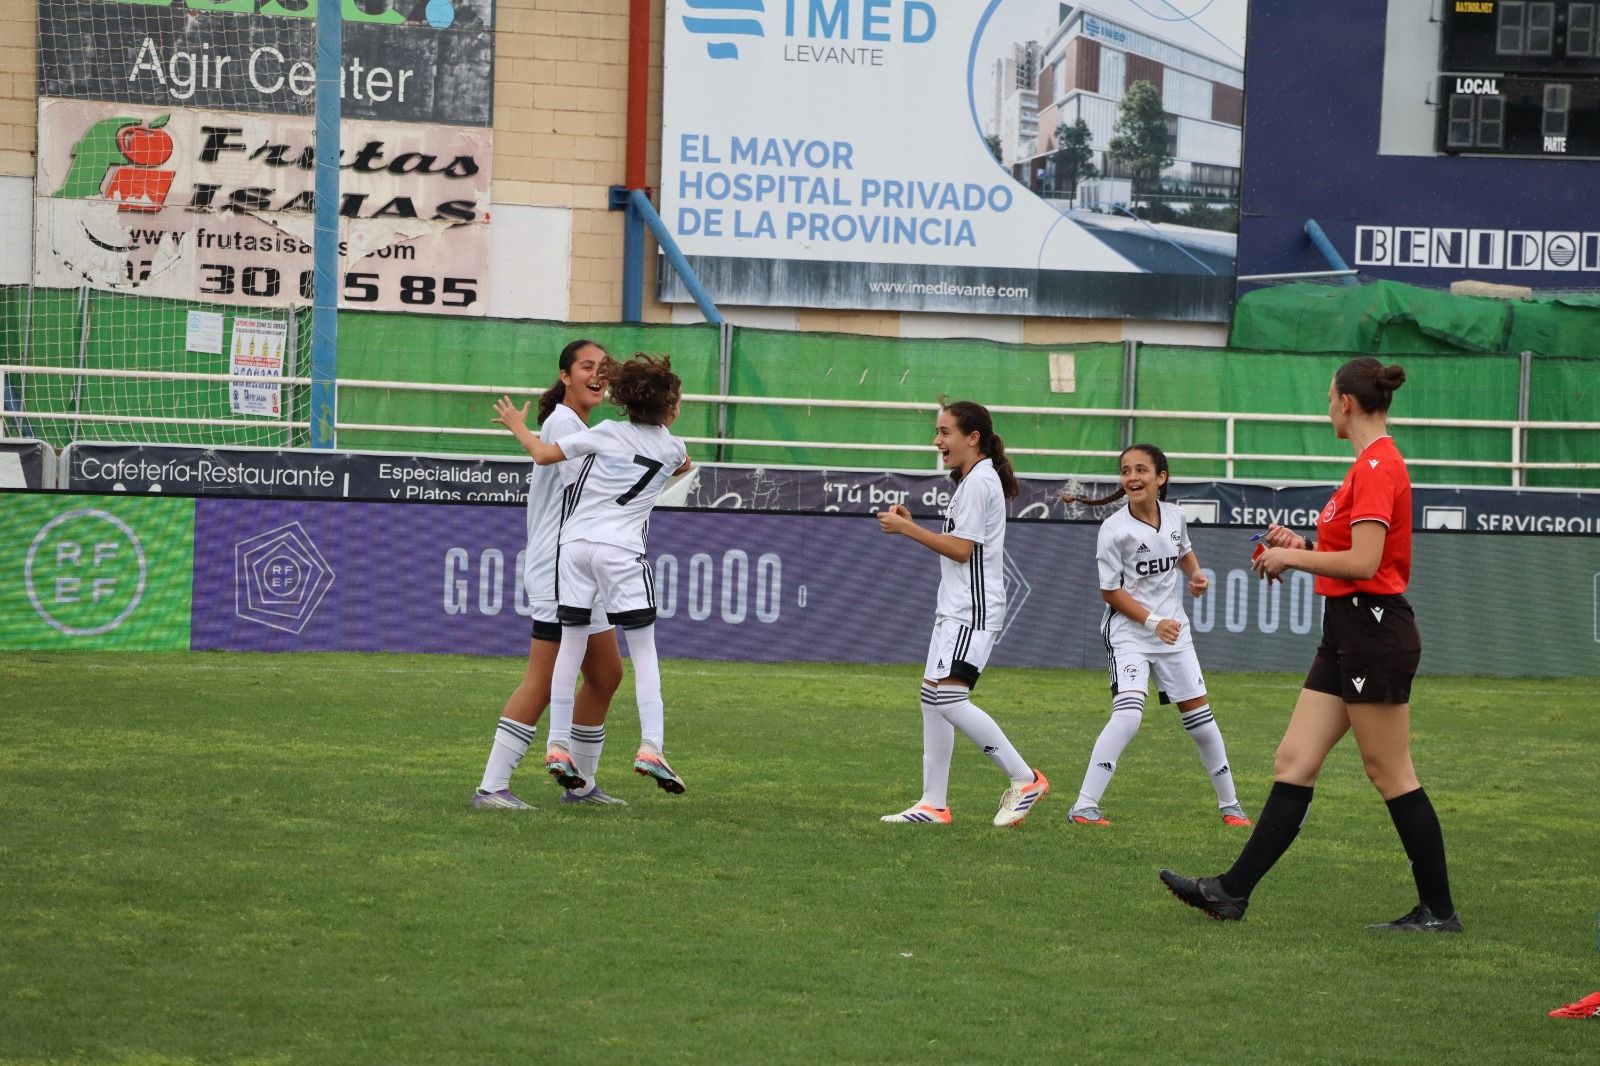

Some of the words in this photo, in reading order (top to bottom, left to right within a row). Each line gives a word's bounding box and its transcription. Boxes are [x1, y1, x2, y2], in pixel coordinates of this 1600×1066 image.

[785, 0, 937, 44] IMED
[129, 37, 233, 99] Agir
[248, 46, 414, 102] Ceter
[784, 44, 884, 66] LEVANTE
[1456, 78, 1499, 95] LOCAL
[680, 134, 720, 163] EL
[730, 136, 854, 170] MAYOR
[1544, 136, 1567, 152] PARTE
[679, 171, 851, 206] HOSPITAL
[860, 180, 1013, 213] PRIVADO
[677, 207, 723, 236] DE
[733, 211, 777, 240] LA
[786, 211, 976, 247] PROVINCIA
[200, 263, 281, 297] 30
[400, 275, 478, 306] 85
[869, 280, 1029, 299] www.imedlevante.com
[81, 457, 335, 488] Cafetería-Restaurante
[379, 463, 492, 483] Especialidad
[498, 471, 519, 484] en
[616, 454, 664, 506] 7
[406, 486, 461, 501] Platos
[869, 484, 910, 505] bar
